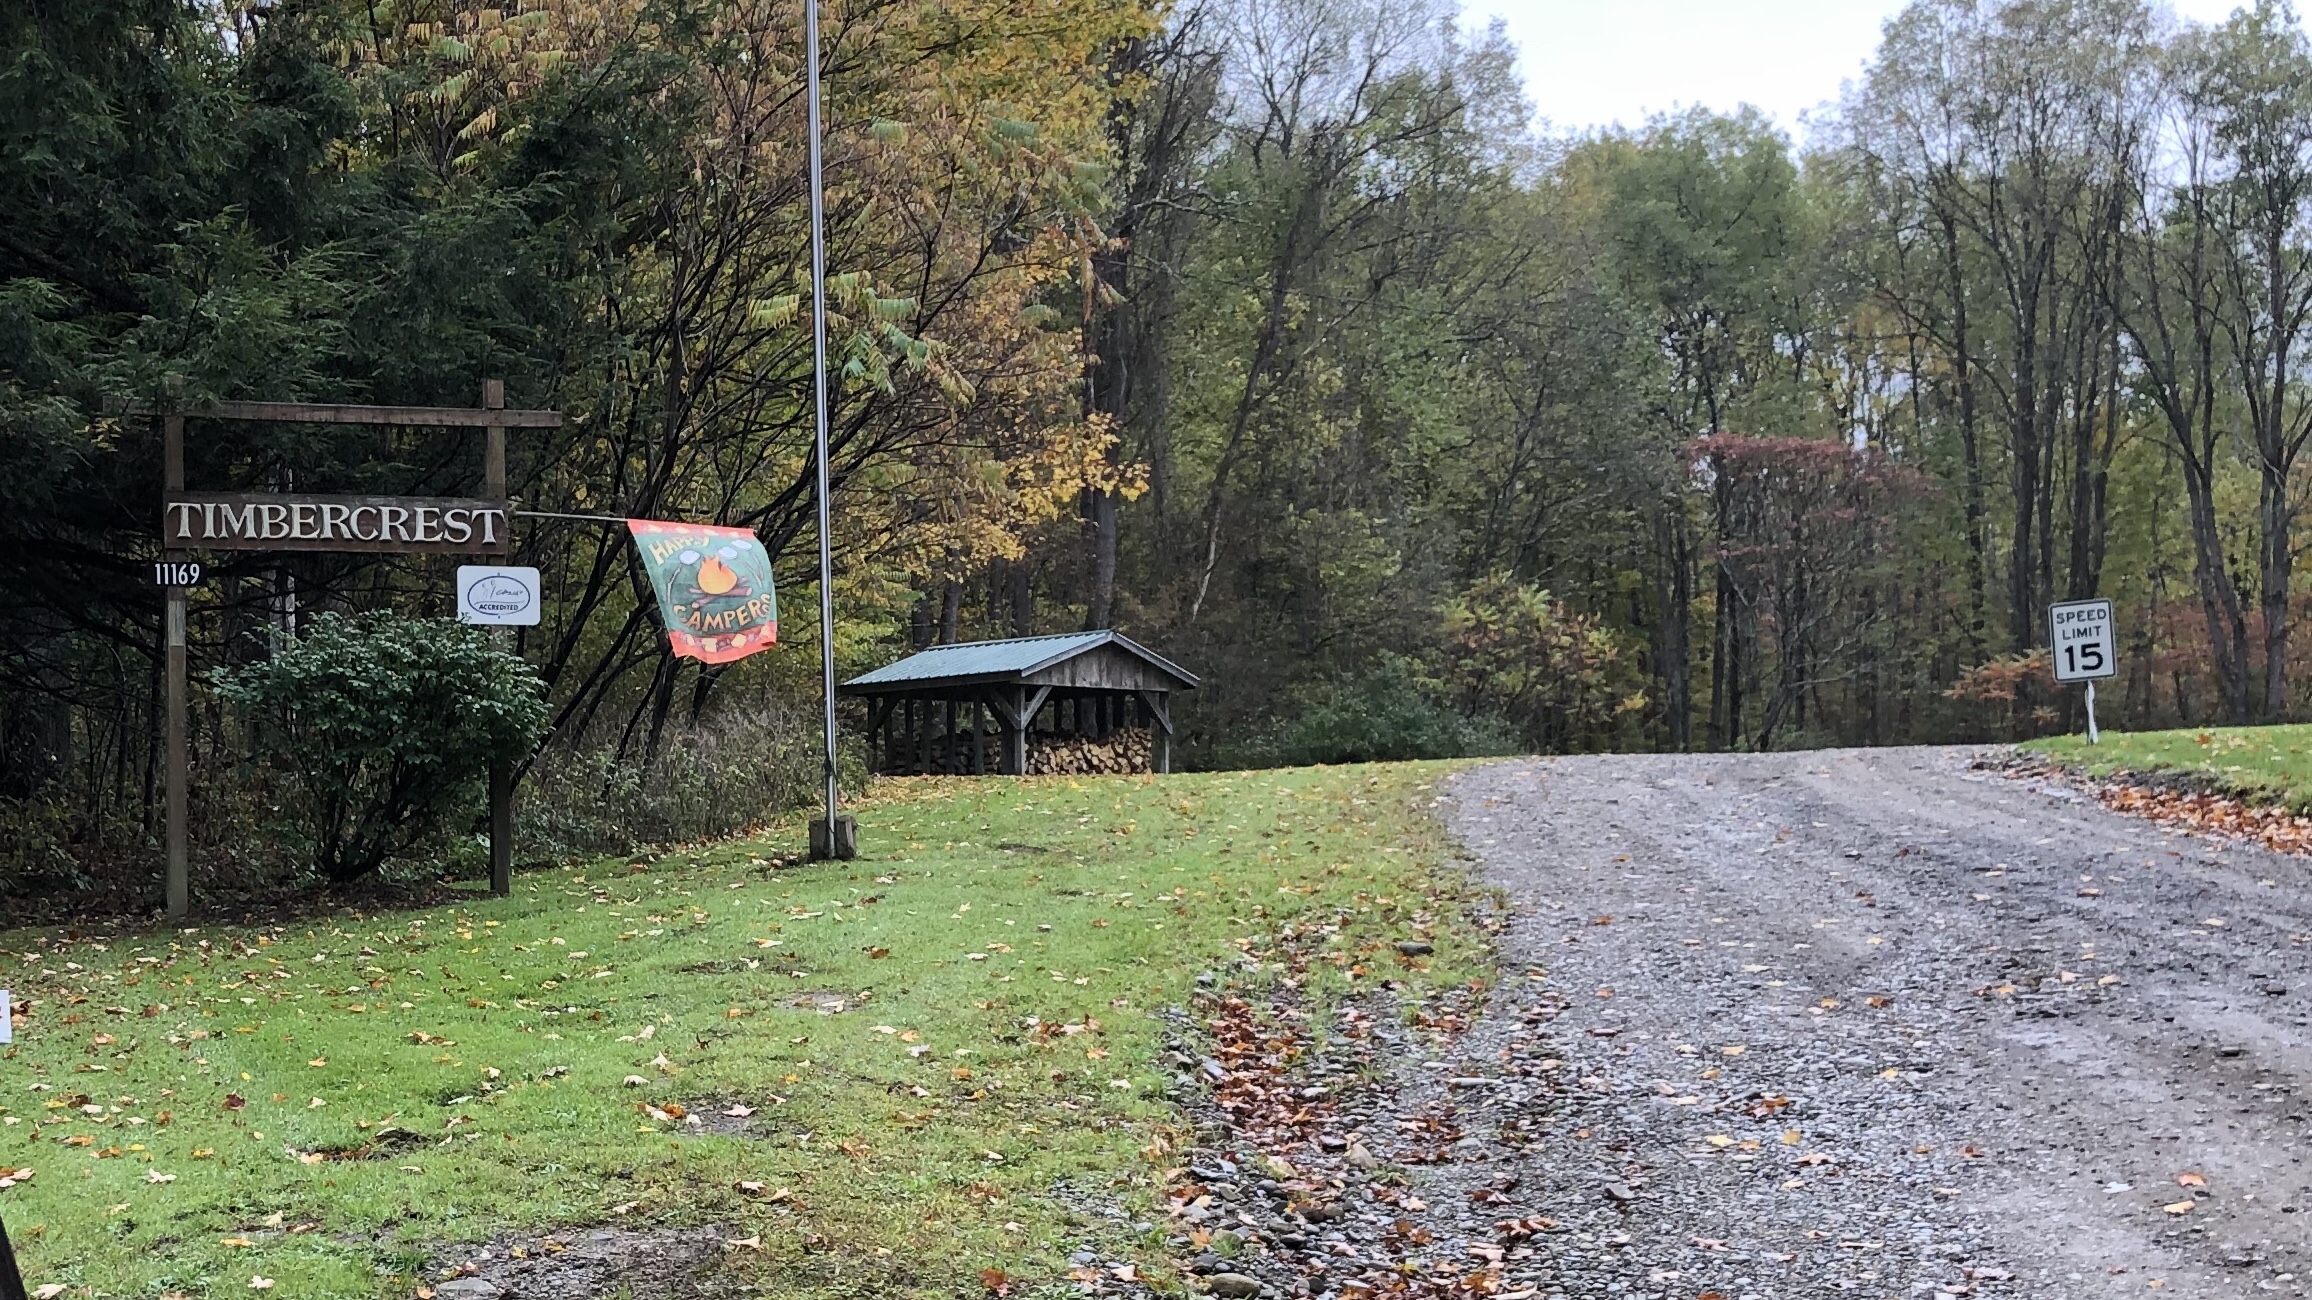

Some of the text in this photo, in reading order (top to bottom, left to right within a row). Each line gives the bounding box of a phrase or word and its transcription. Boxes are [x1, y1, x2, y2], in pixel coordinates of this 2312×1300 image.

[167, 502, 504, 544] TIMBERCREST
[647, 535, 710, 566] HAPPY
[155, 563, 200, 585] 11169
[673, 593, 771, 632] CAMPERS
[2056, 609, 2107, 624] SPEED
[2062, 625, 2102, 640] LIMIT
[2065, 643, 2103, 672] 15
